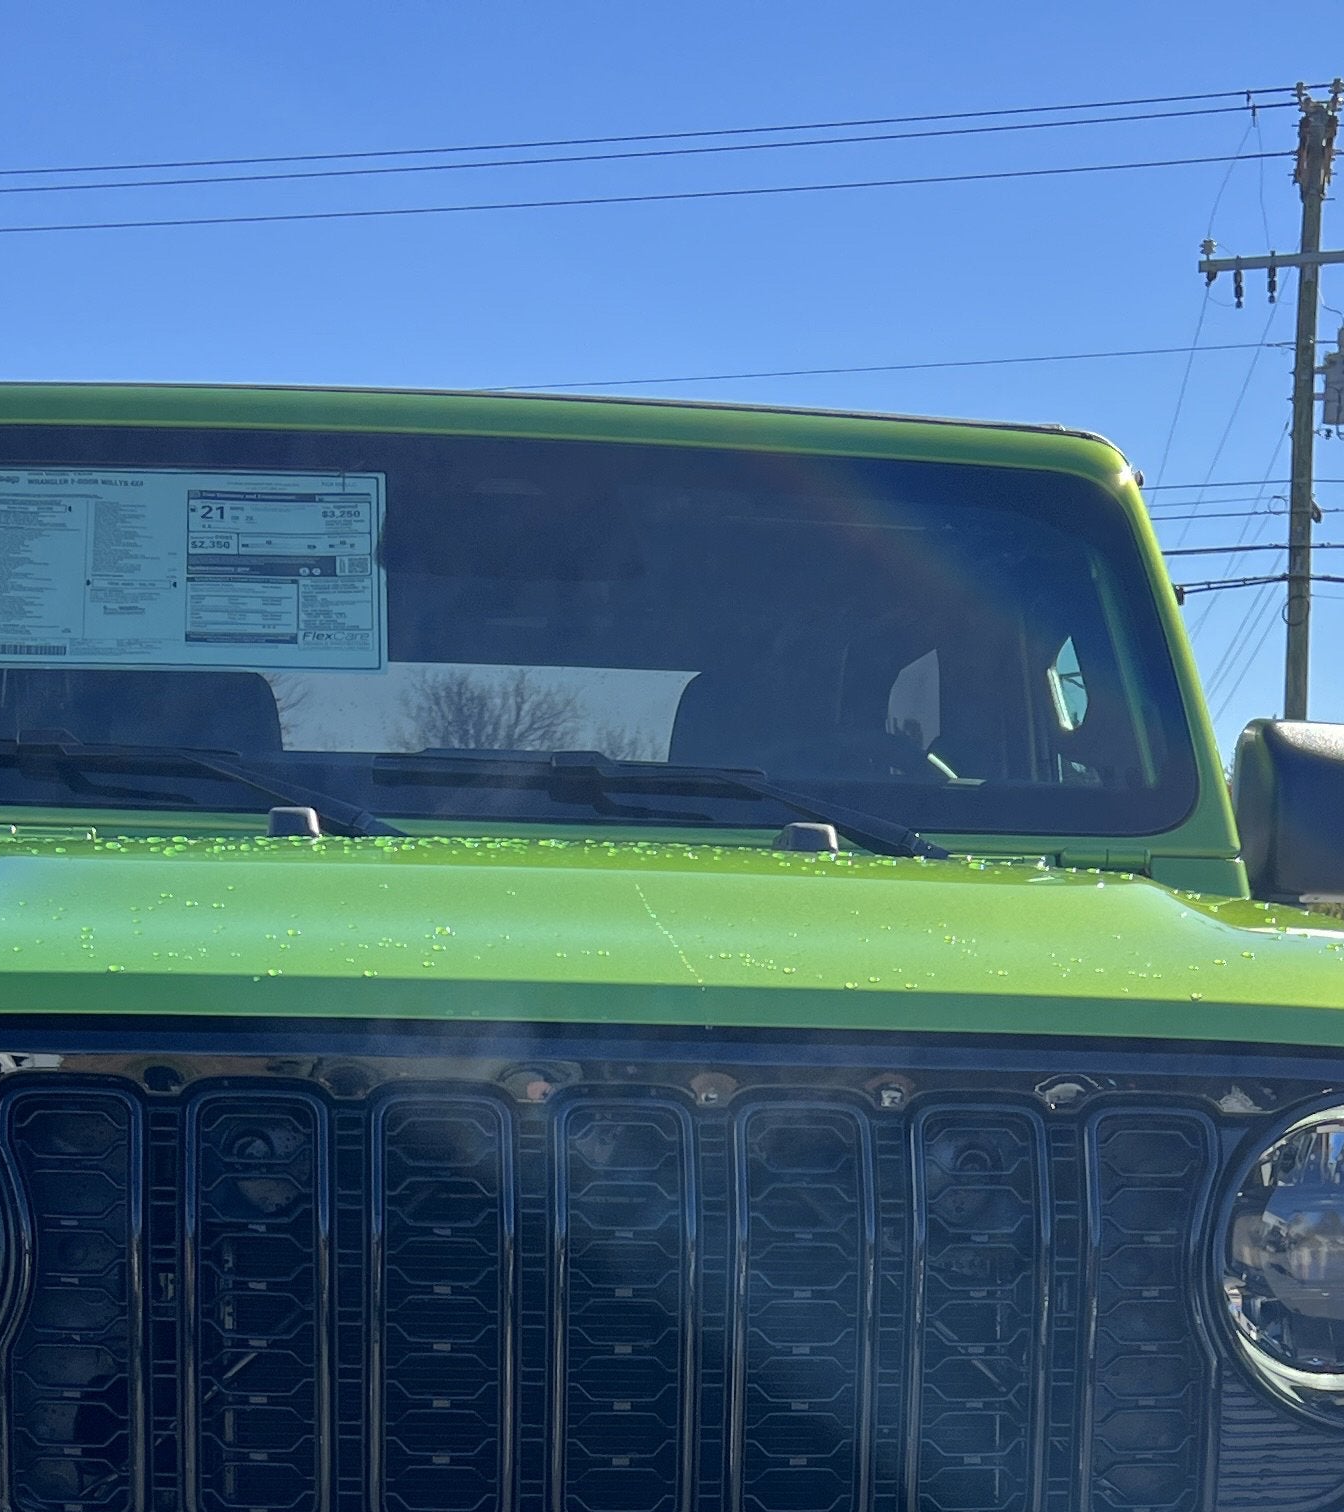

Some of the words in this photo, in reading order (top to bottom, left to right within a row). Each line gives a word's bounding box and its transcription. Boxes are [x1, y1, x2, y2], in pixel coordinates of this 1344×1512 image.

[200, 505, 225, 520] 21
[321, 510, 361, 518] $3,250
[302, 631, 370, 641] FlexCare
